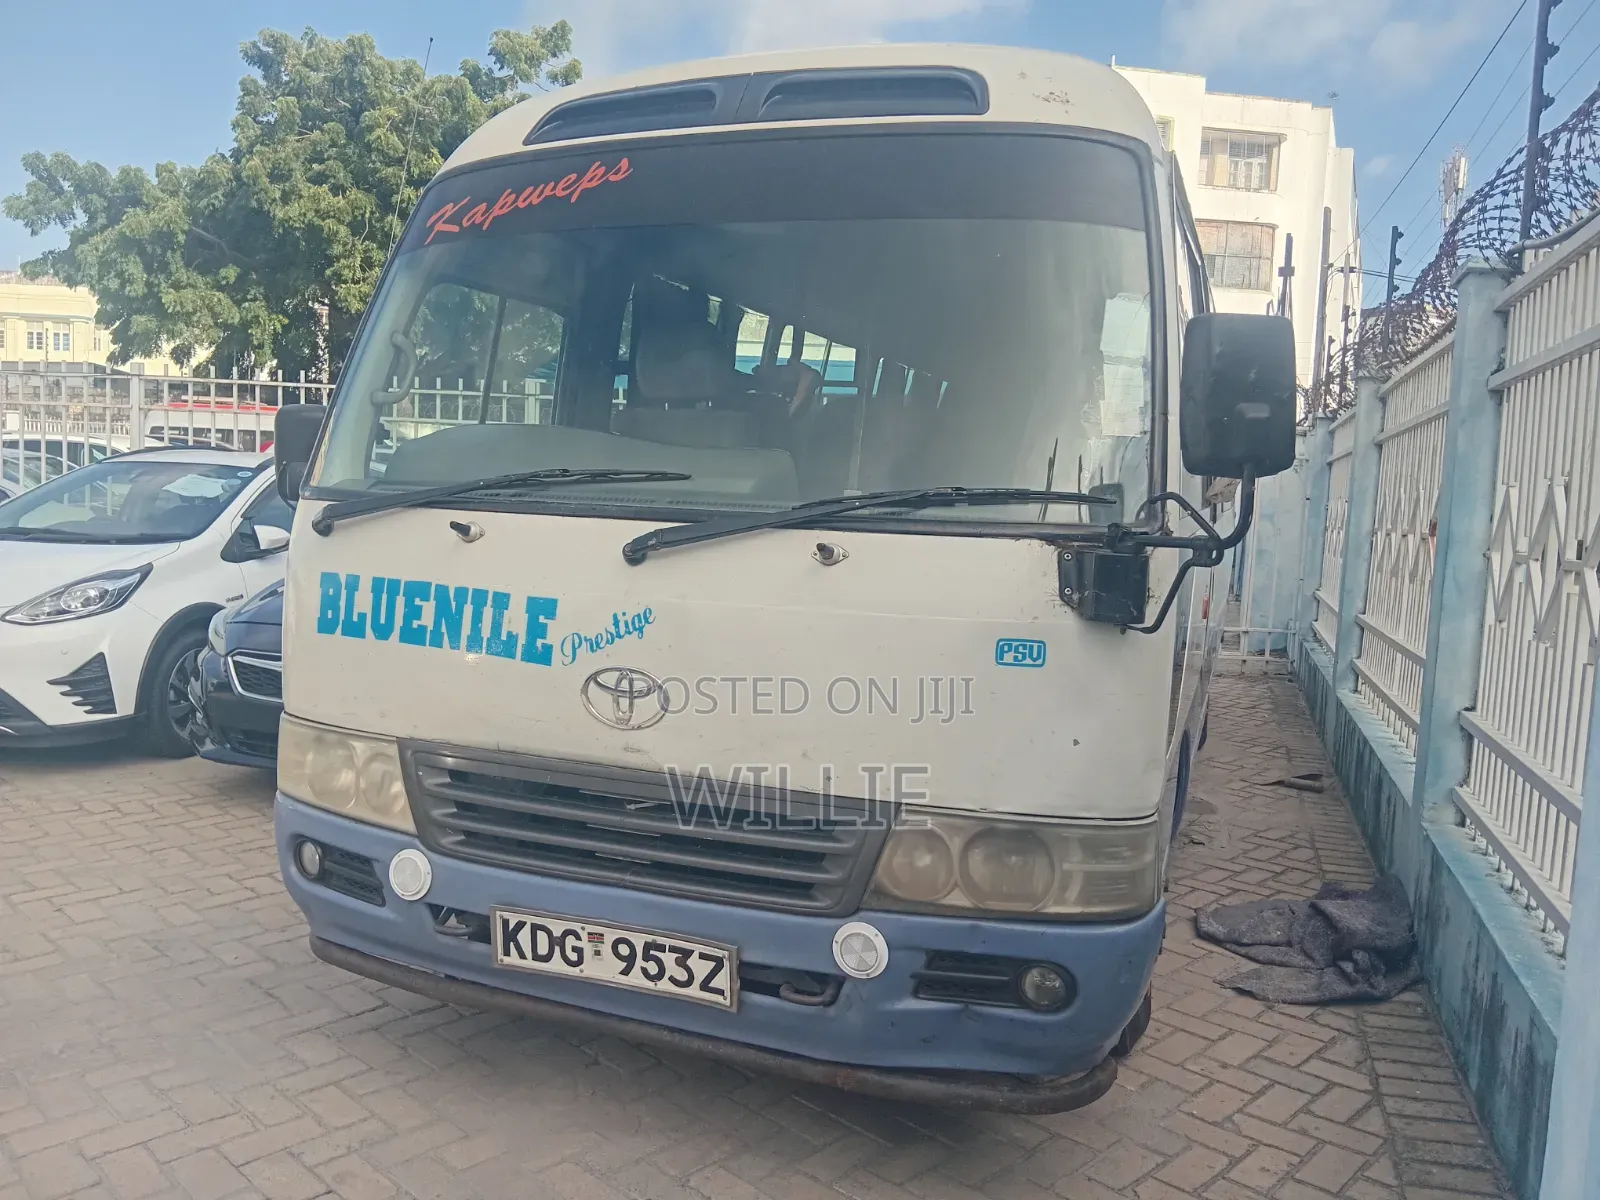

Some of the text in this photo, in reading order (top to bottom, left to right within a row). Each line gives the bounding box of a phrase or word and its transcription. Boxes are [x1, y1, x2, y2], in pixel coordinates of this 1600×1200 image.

[424, 157, 633, 246] Kapweps
[317, 571, 656, 667] BLUENILE Prestige
[501, 917, 726, 998] KDG 953Z
